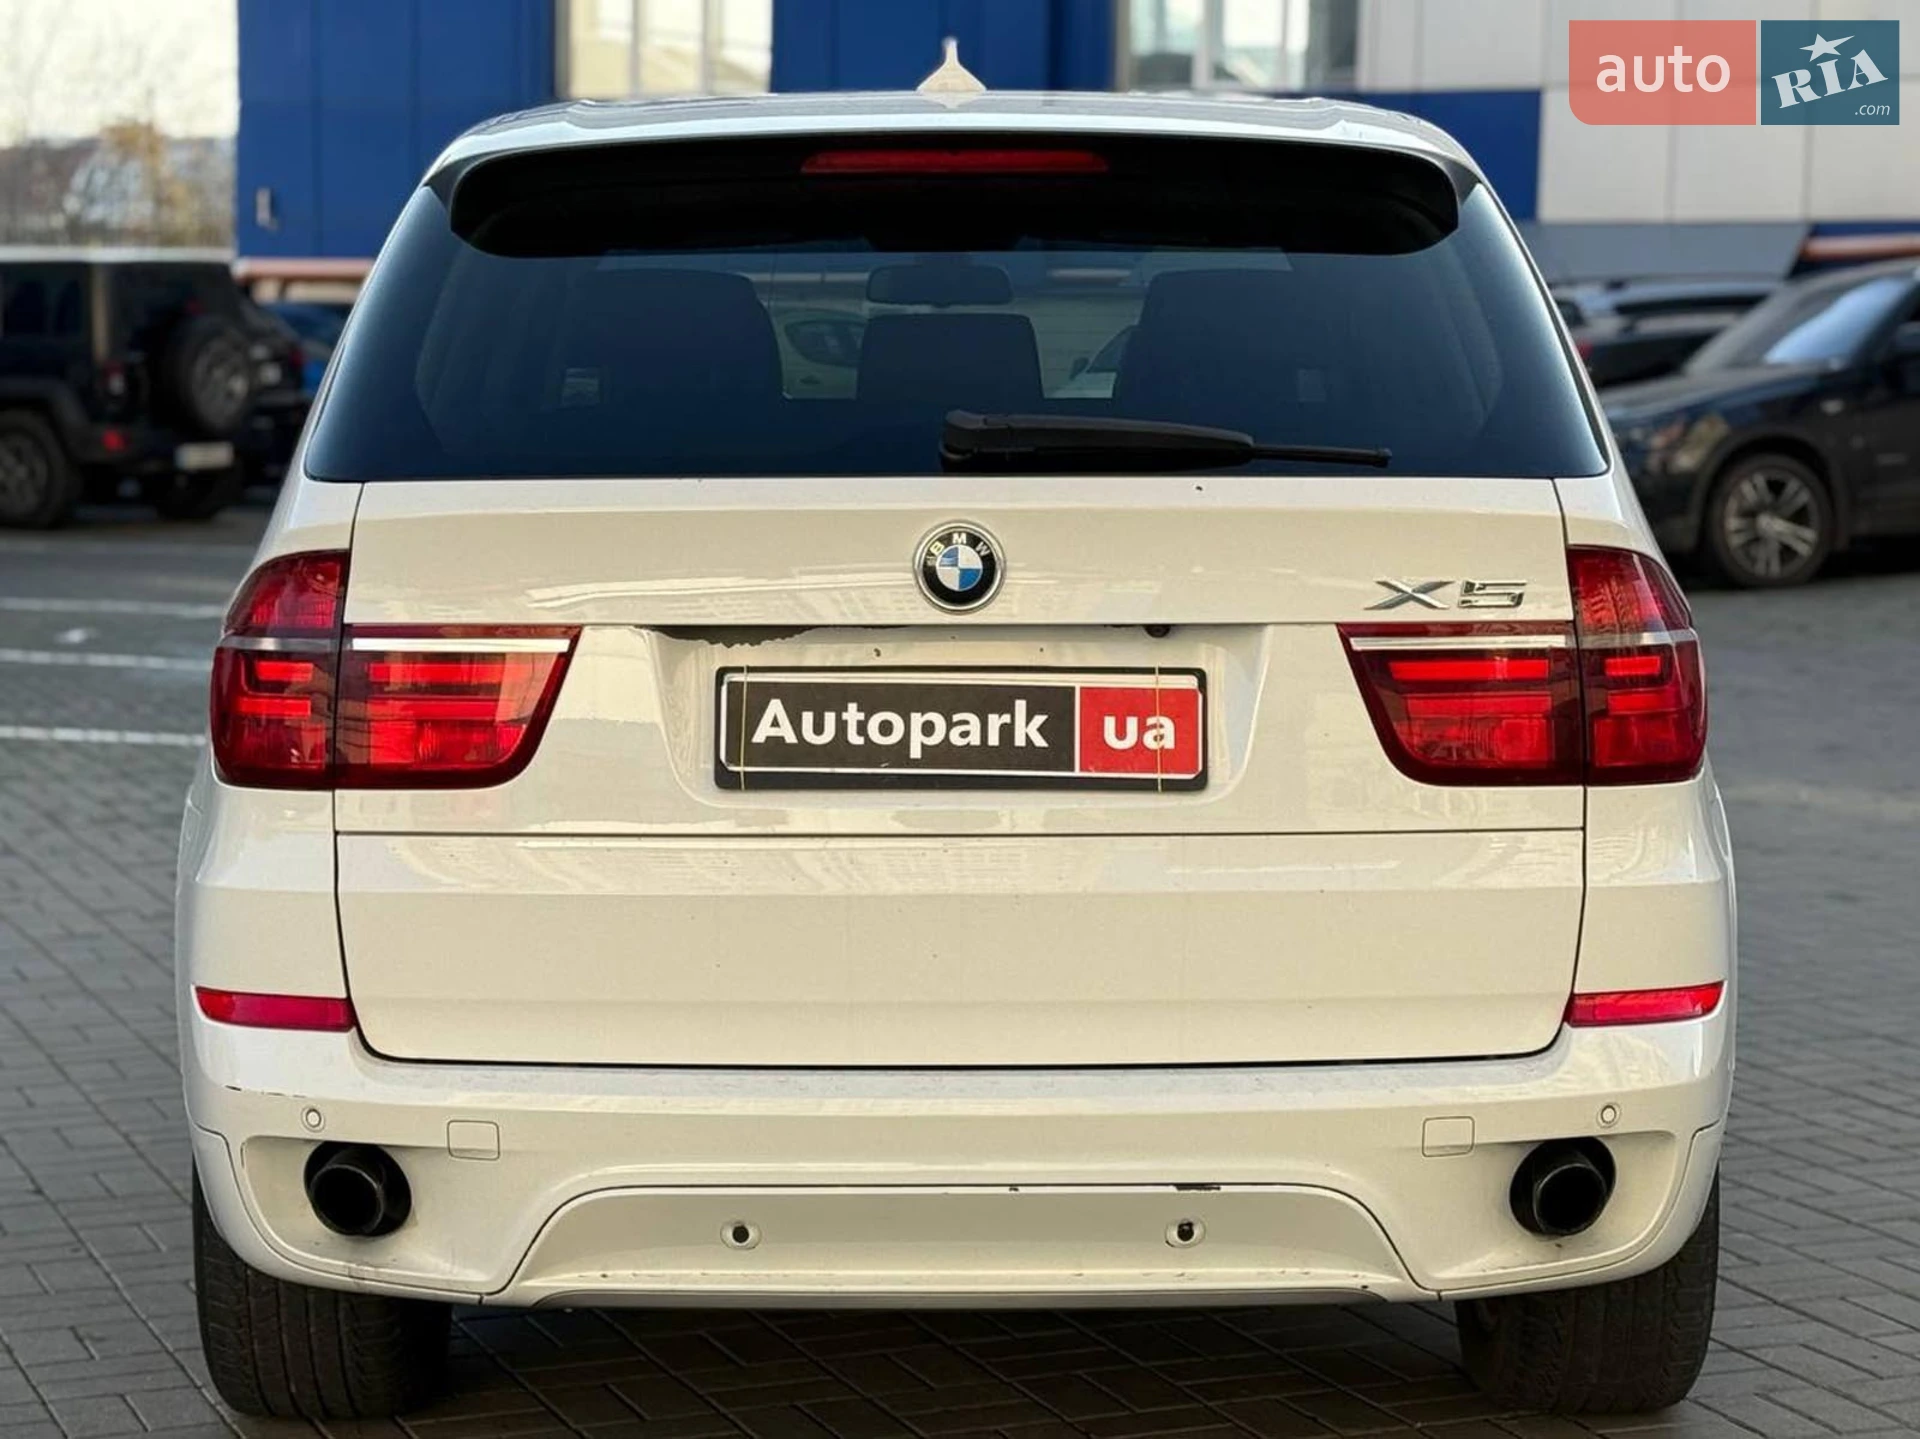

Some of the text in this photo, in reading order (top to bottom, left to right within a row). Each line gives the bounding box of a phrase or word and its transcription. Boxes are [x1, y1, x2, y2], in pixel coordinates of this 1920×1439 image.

[929, 532, 991, 557] BMW
[1363, 579, 1528, 611] X5
[751, 698, 1176, 759] Autopark ua
